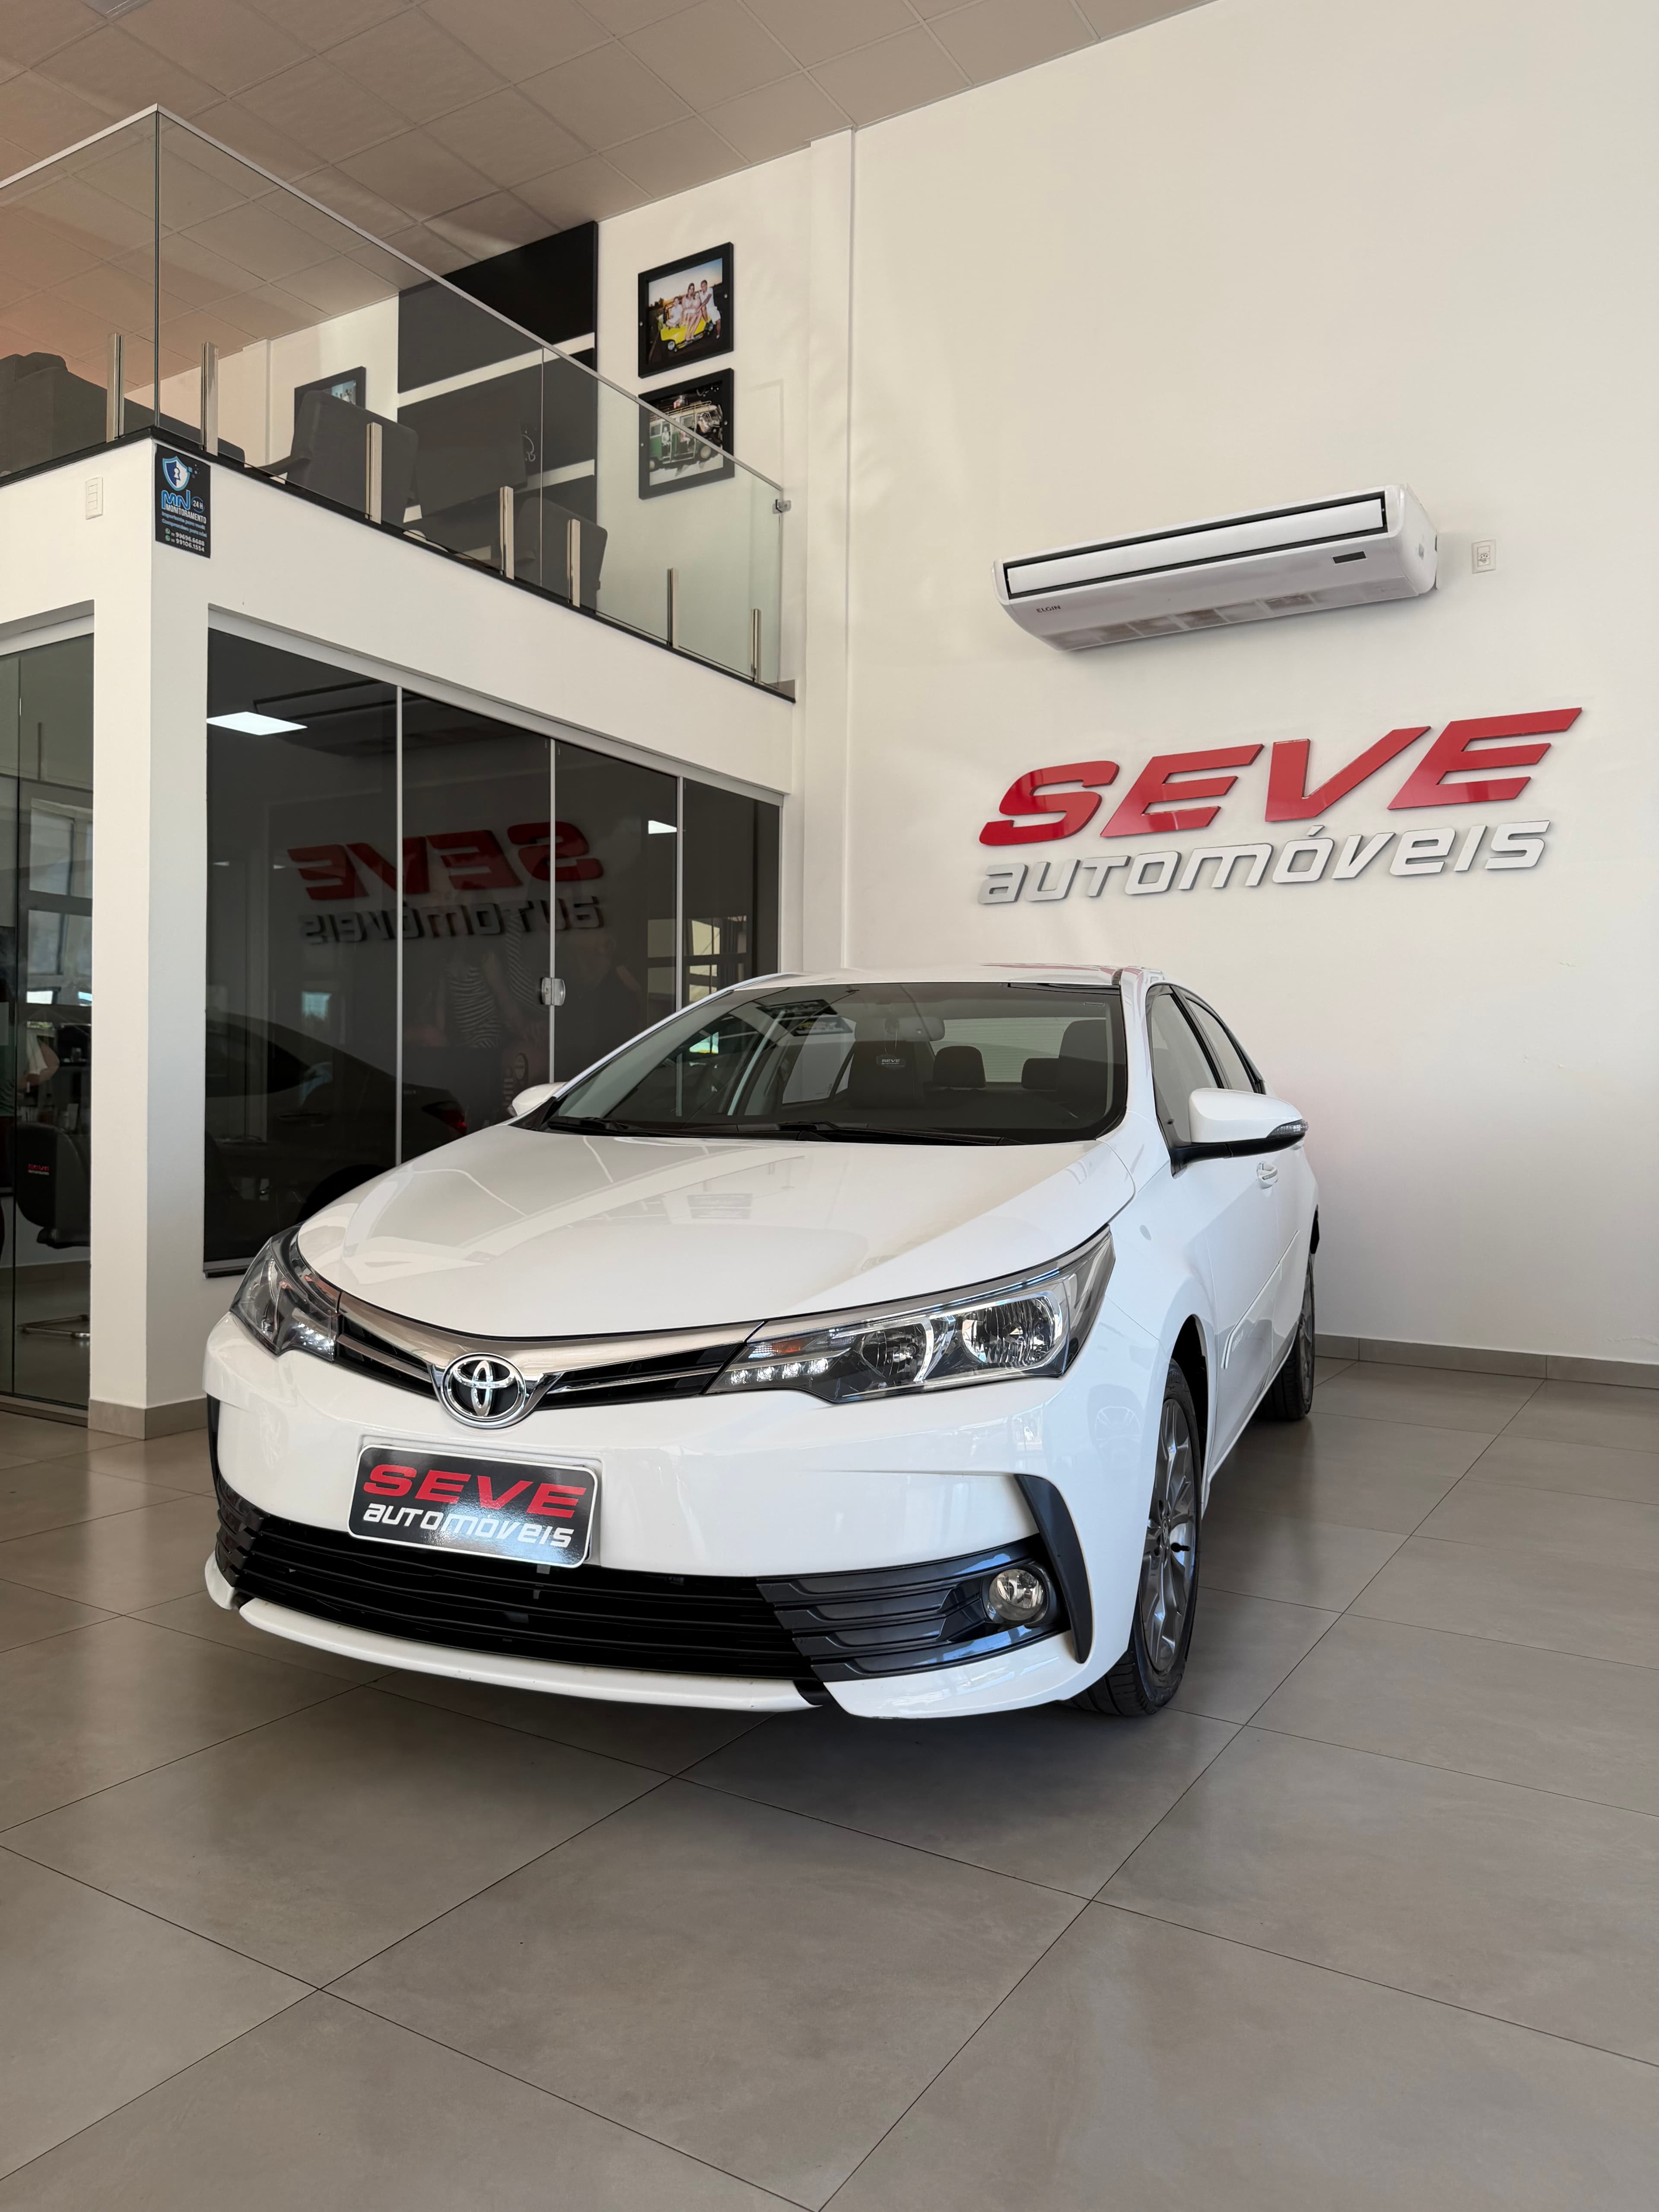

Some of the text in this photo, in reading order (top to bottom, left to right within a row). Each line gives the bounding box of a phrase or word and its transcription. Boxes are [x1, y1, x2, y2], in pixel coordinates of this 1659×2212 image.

[161, 489, 191, 511] MN
[165, 504, 207, 524] MONITORAMENTO
[979, 707, 1583, 846] SEVE
[363, 1464, 587, 1519] SEVE
